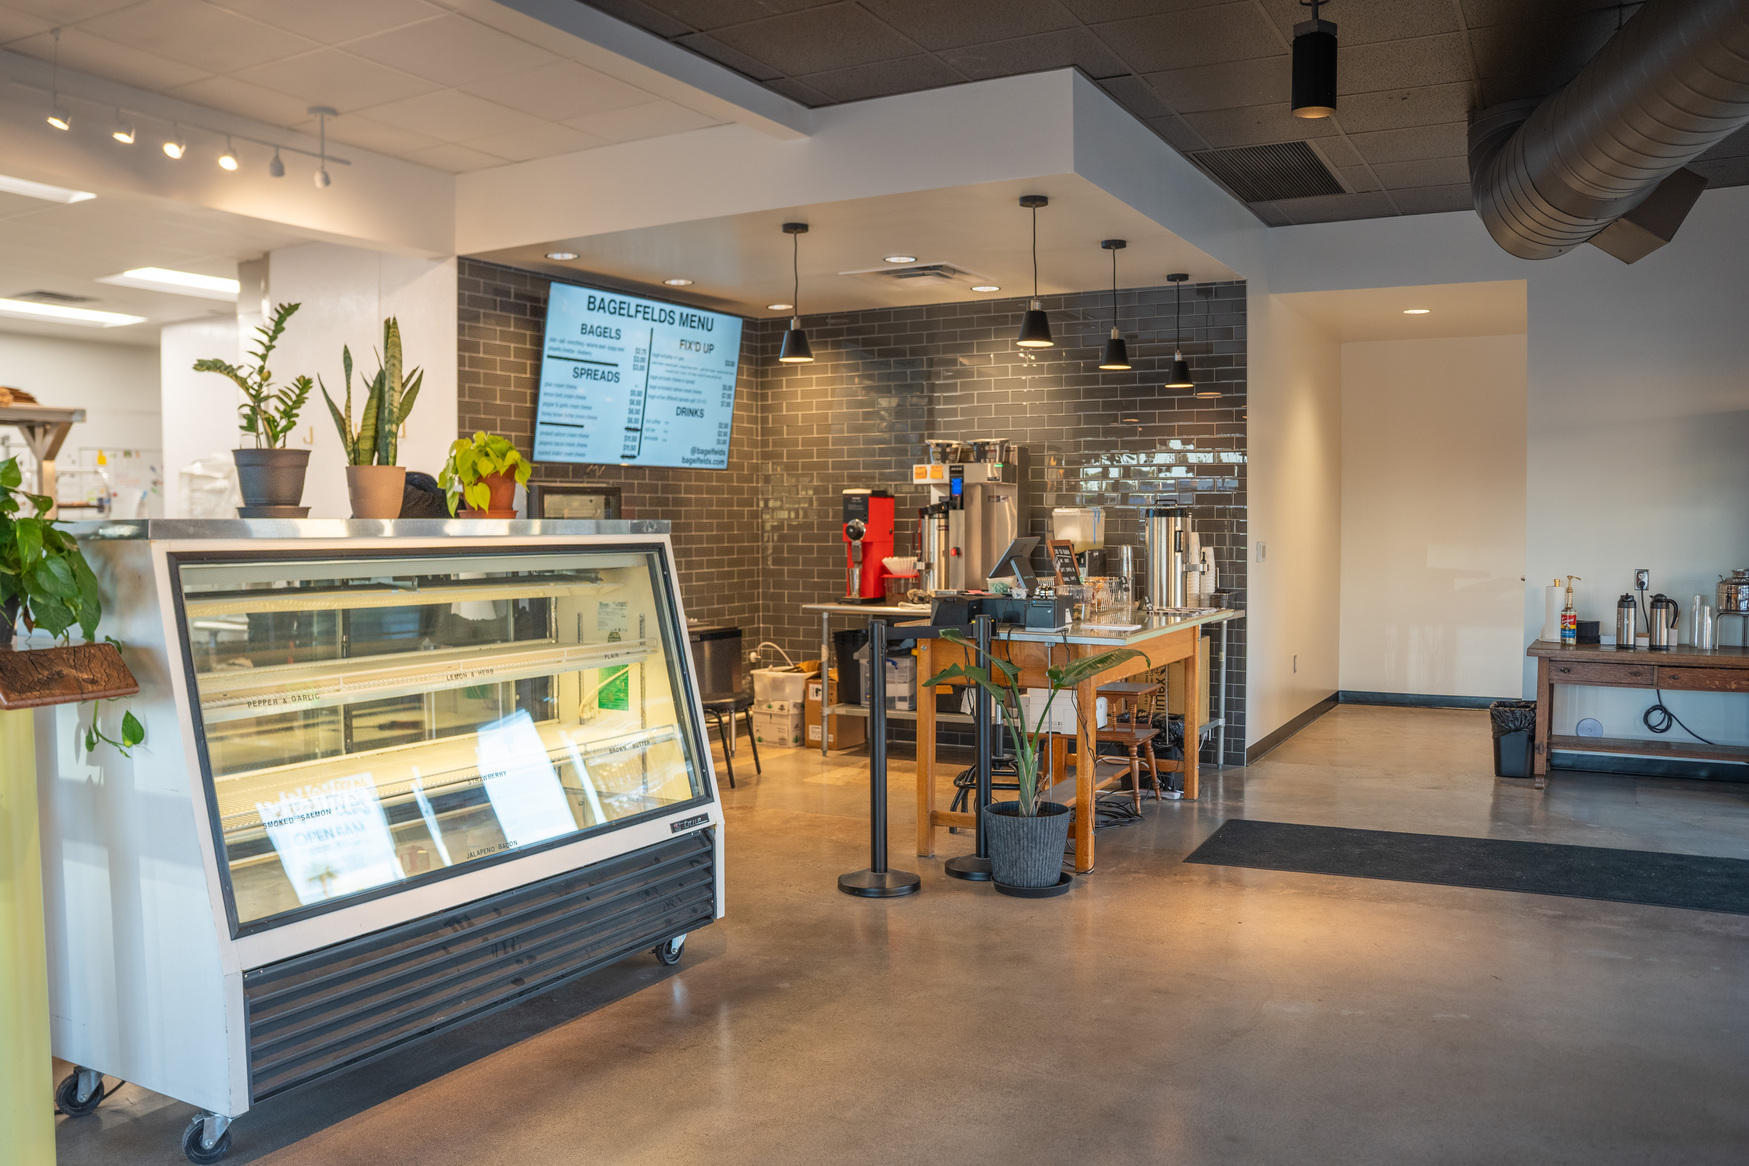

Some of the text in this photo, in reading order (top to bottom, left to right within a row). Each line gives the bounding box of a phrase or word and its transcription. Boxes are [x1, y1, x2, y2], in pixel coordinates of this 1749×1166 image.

[587, 295, 714, 332] BAGELFELDS MENU
[580, 323, 622, 340] BAGELS
[680, 339, 715, 354] FIX'D UP
[572, 366, 621, 383] SPREADS
[676, 406, 705, 418] DRINKS
[690, 446, 726, 457] @bagelfelds
[682, 456, 725, 466] bagelfelds.com
[604, 652, 620, 660] PLAIN
[446, 672, 468, 681] LEMON
[247, 698, 278, 708] PEPPER
[290, 693, 320, 703] GARLIC
[467, 770, 507, 786] STRAWBERRY
[262, 808, 332, 830] SMOKED SALMON
[466, 840, 518, 860] JALAPENO BACON
